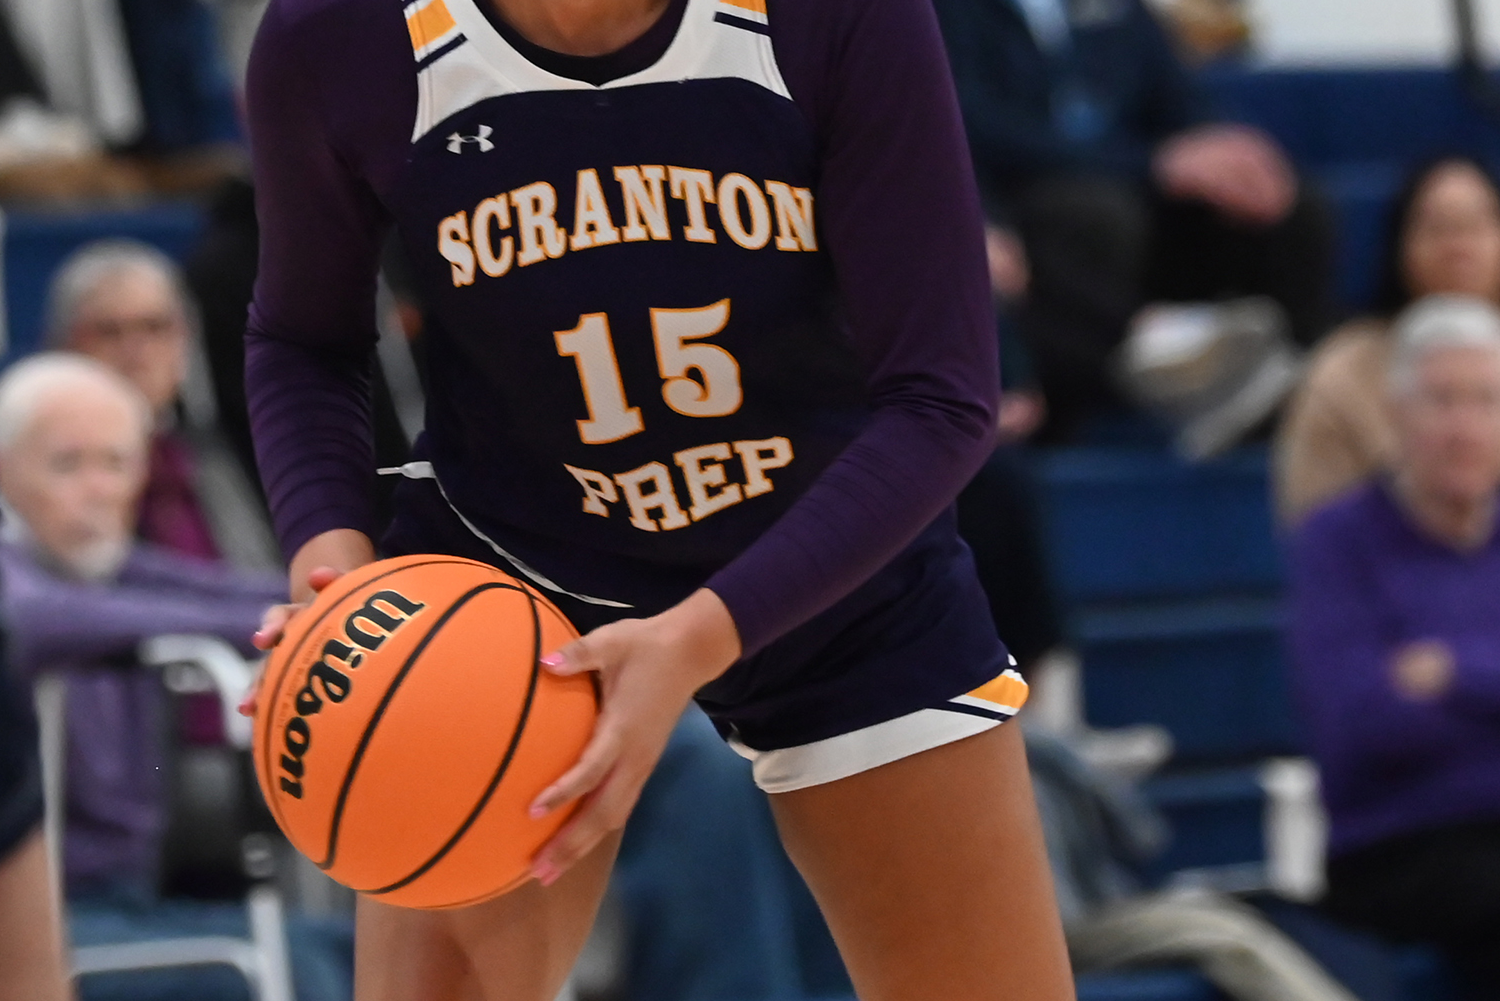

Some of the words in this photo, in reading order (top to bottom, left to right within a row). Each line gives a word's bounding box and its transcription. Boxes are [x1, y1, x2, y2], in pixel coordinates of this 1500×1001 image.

[437, 164, 819, 288] SCRANTON
[552, 298, 744, 446] 15
[563, 436, 795, 532] PREP
[279, 589, 427, 799] Wilson
